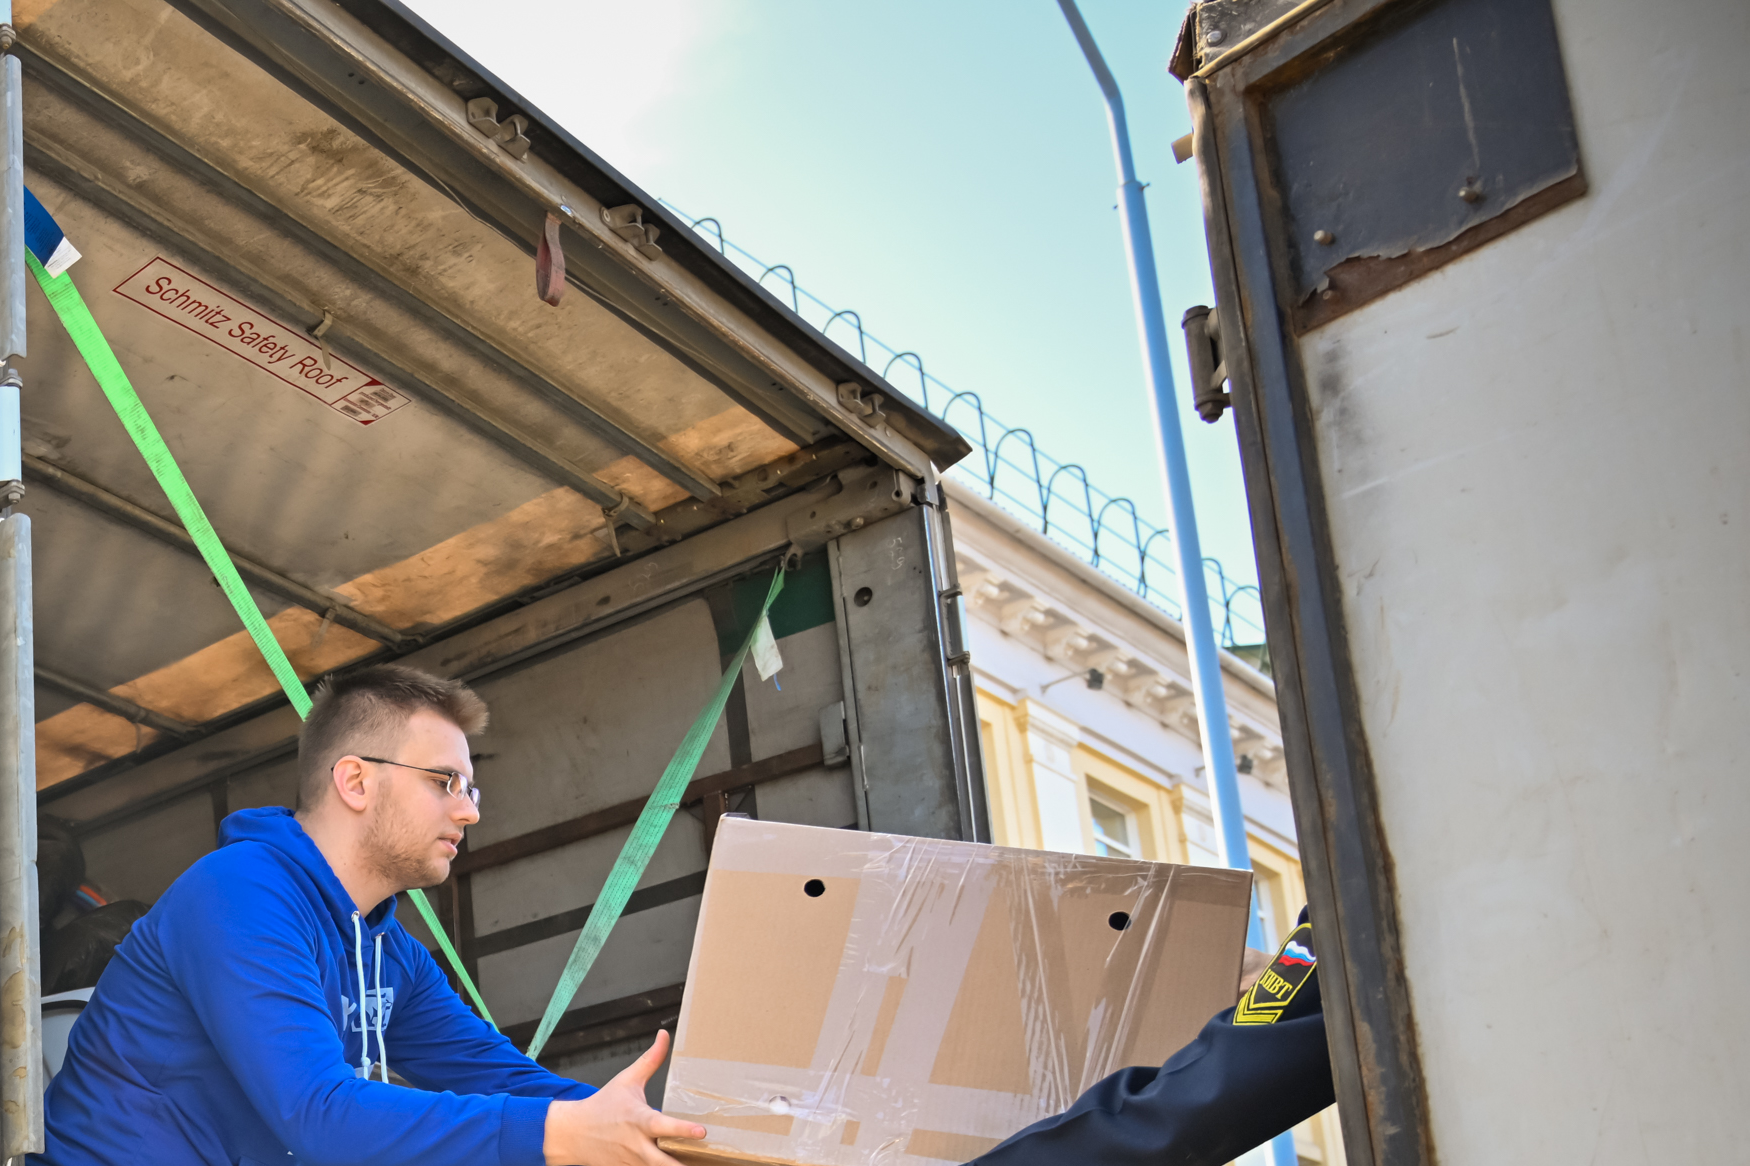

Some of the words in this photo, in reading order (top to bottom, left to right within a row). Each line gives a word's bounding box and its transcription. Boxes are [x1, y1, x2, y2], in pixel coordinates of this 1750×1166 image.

[144, 275, 234, 330] Schmitz
[227, 320, 296, 365] Safety
[289, 355, 350, 390] Roof
